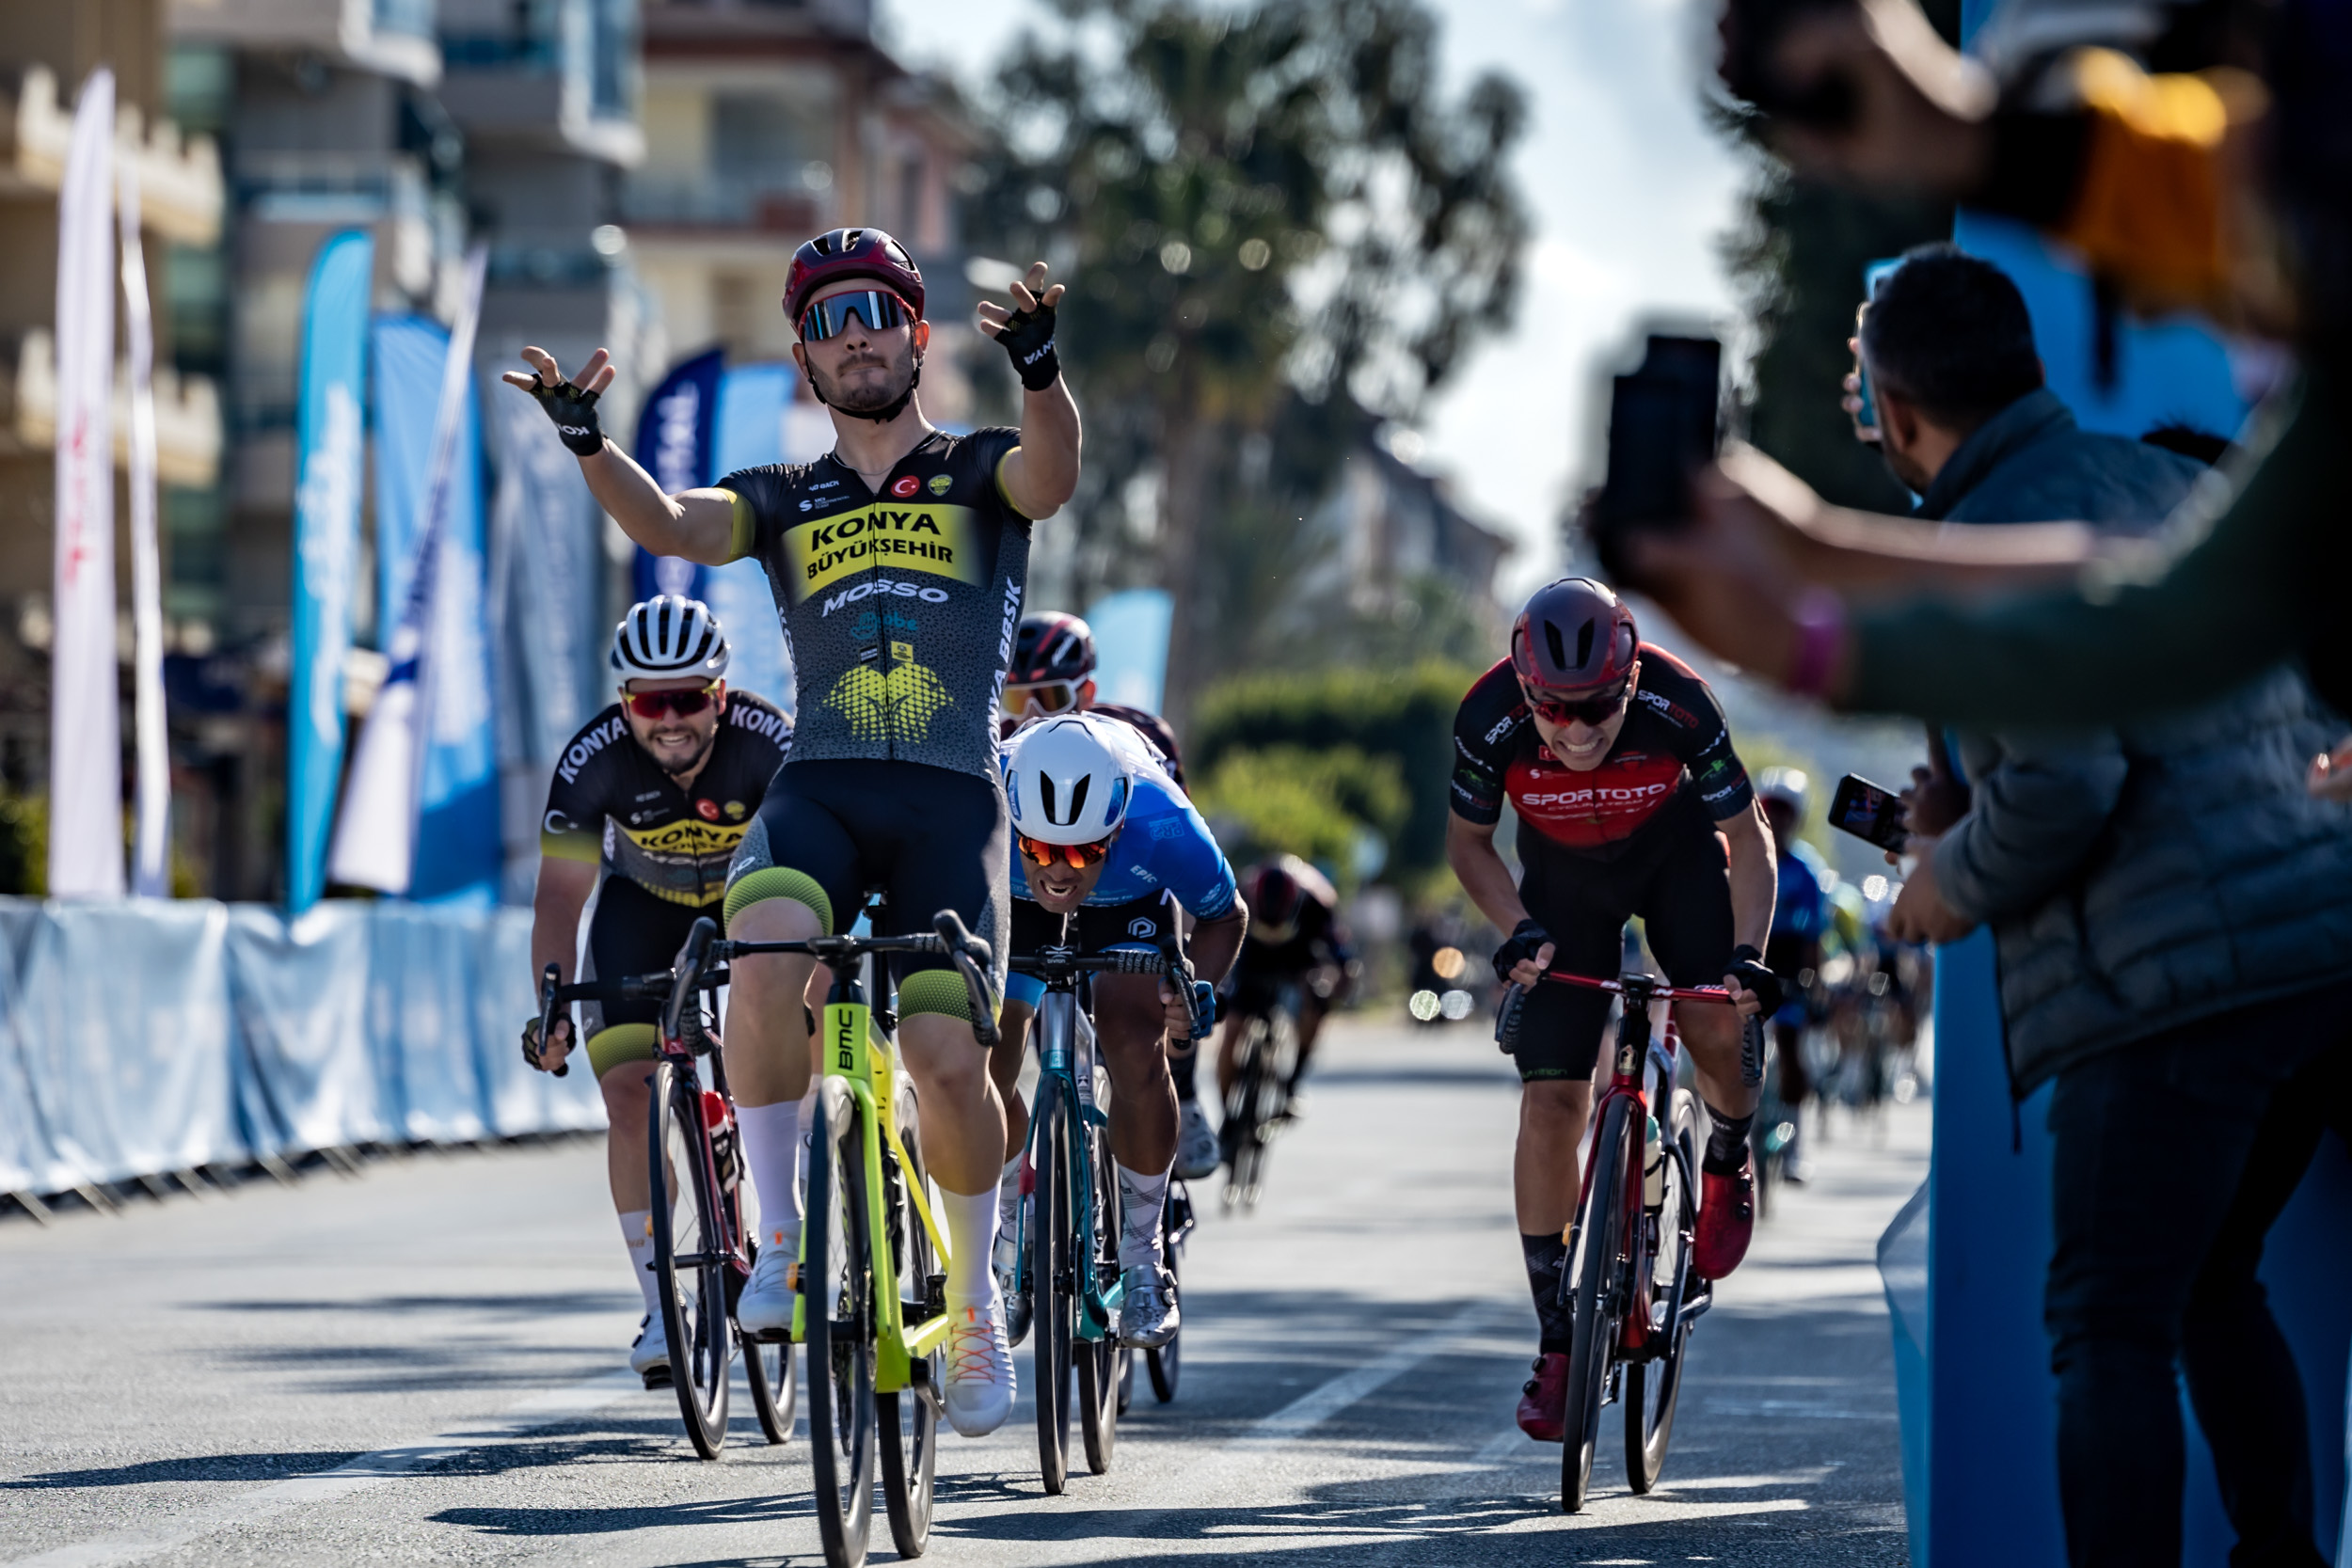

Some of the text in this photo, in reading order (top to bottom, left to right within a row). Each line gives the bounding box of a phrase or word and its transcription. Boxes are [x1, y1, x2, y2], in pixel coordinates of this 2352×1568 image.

[1024, 336, 1055, 365] NYA
[811, 510, 941, 552] KONYA
[807, 537, 953, 579] BÜYÜKŞEHİR
[821, 578, 948, 618] MOSSO
[999, 576, 1022, 664] BBSK
[558, 716, 628, 784] KONYA
[1130, 865, 1157, 882] EPIC
[838, 1008, 853, 1070] BMC
